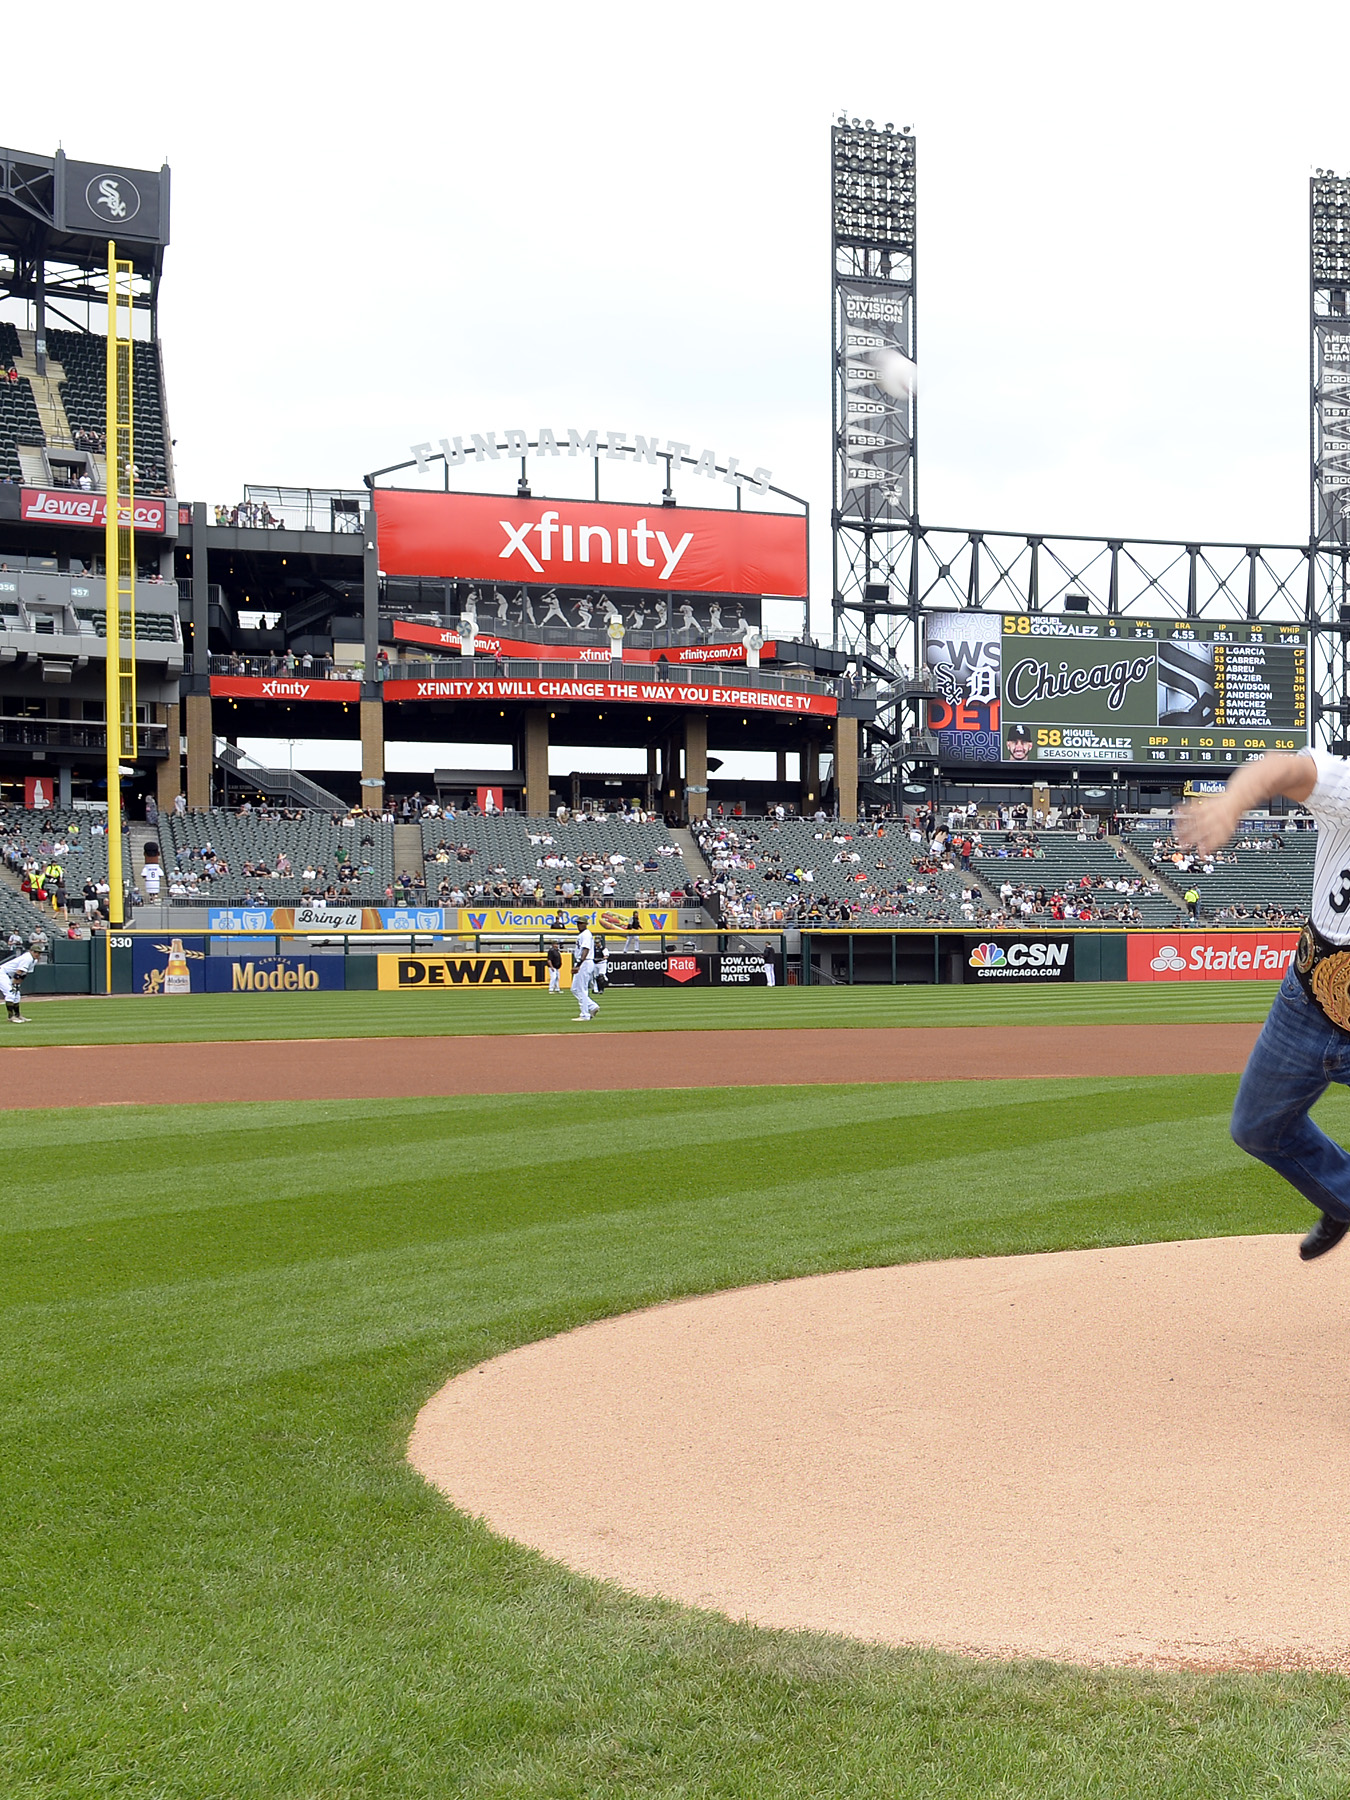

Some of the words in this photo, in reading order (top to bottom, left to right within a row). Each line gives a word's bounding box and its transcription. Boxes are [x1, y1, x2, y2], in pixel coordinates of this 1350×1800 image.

[847, 295, 878, 303] AMERICAN
[880, 298, 902, 306] LEAGUE
[847, 301, 902, 316] DIVISION
[847, 311, 902, 323] CHAMPIONS
[848, 336, 884, 347] 2008
[848, 403, 885, 414] 2000
[849, 436, 885, 446] 1993
[410, 428, 773, 496] FUNDAMENTALS
[849, 469, 885, 479] 1983
[498, 510, 694, 580] xfinity
[72, 588, 88, 596] 357
[1004, 616, 1030, 634] 58
[1030, 616, 1062, 625] MIGUEL
[1110, 628, 1116, 636] 9
[1135, 629, 1154, 638] 3-5
[1170, 630, 1194, 640] 4.55
[1214, 632, 1236, 641] 55.1
[1250, 634, 1263, 642] 33
[1280, 634, 1300, 644] 1.48
[679, 646, 742, 660] xfinity.com/x1
[1006, 655, 1155, 710] Chicago
[262, 680, 310, 698] xfinity
[417, 682, 474, 696] XFINITY
[477, 682, 494, 695] X1
[498, 682, 536, 695] WILL
[538, 682, 604, 696] CHANGE
[608, 684, 638, 698] THE
[642, 686, 676, 700] WAY
[678, 687, 709, 701] YOU
[712, 690, 794, 708] EXPERIENCE
[797, 696, 811, 709] TV
[1226, 692, 1272, 700] ANDERSON
[928, 700, 1000, 731] DET
[1037, 729, 1062, 746] 58
[1062, 729, 1096, 737] MIGUEL
[1062, 737, 1132, 748] GONZALEZ
[1148, 736, 1168, 746] BFP
[1180, 738, 1188, 746] H
[1200, 738, 1214, 746] SO
[1222, 738, 1236, 747] BB
[1244, 739, 1266, 748] OBA
[1275, 740, 1294, 748] SLG
[1044, 750, 1080, 758] SEASON
[1094, 750, 1128, 759] LEFTIES
[1152, 751, 1166, 760] 116
[1180, 752, 1190, 760] 31
[1226, 752, 1232, 760] 8
[1246, 753, 1265, 761] .290
[1200, 782, 1226, 792] Modelo
[298, 910, 342, 928] Bring
[346, 914, 357, 926] it
[496, 910, 554, 926] Vienna
[110, 938, 132, 948] 330
[1007, 944, 1068, 966] CSN
[258, 957, 291, 966] CERVEZA
[608, 958, 668, 974] guaranteed
[670, 959, 694, 970] Rate
[720, 956, 744, 966] LOW,
[232, 963, 320, 991] Modelo
[978, 968, 1061, 977] CSNCHICAGO.COM
